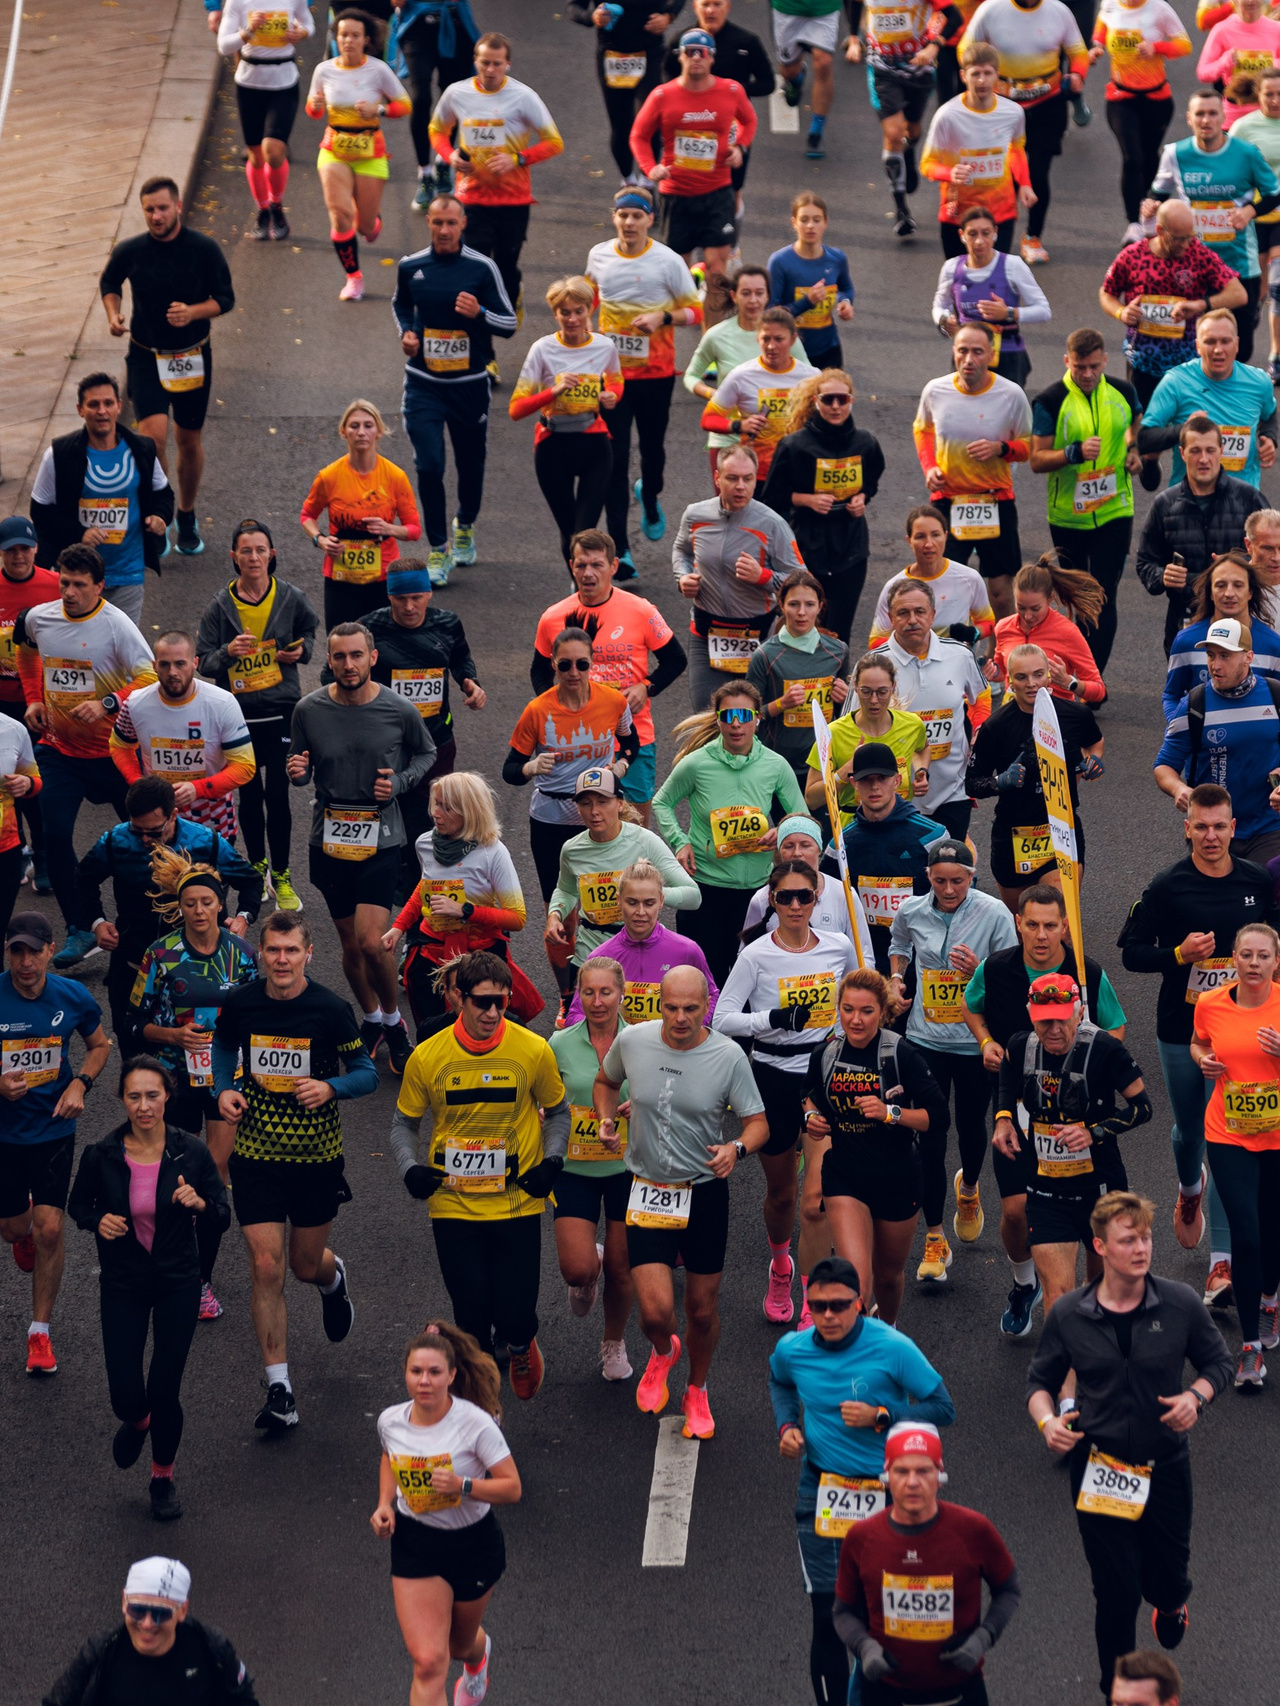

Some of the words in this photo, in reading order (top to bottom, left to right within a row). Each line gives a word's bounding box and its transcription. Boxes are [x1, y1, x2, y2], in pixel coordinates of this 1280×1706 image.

[680, 139, 714, 153] 16529
[1184, 173, 1212, 184] БЕГУ
[426, 341, 467, 353] 12768
[167, 359, 193, 371] 456
[823, 469, 856, 483] 5563
[1082, 483, 1108, 496] 314
[82, 510, 126, 525] 17007
[957, 506, 992, 520] 7875
[342, 551, 374, 565] 1968
[711, 639, 758, 651] 13928
[235, 652, 269, 673] 2040
[51, 670, 87, 685] 4391
[235, 680, 242, 688] C
[395, 680, 442, 696] 15738
[154, 750, 204, 766] 15164
[332, 822, 372, 838] 2297
[718, 816, 761, 835] 9748
[1022, 863, 1029, 872] D
[868, 914, 875, 923] D
[788, 986, 830, 1007] 5932
[11, 1051, 52, 1066] 9301
[258, 1050, 301, 1068] 6070
[1227, 1094, 1278, 1112] 12590
[573, 1145, 580, 1155] D
[453, 1152, 496, 1169] 6771
[640, 1186, 682, 1208] 1281
[631, 1211, 640, 1222] C
[644, 1206, 674, 1214] ГРИГОРИЙ
[1093, 1469, 1141, 1492] 3809
[827, 1491, 876, 1511] 9419
[1096, 1488, 1132, 1501] ВЛАДИСЛАВ
[835, 1511, 866, 1520] ДМИТРИЙ
[887, 1592, 951, 1611] 14582
